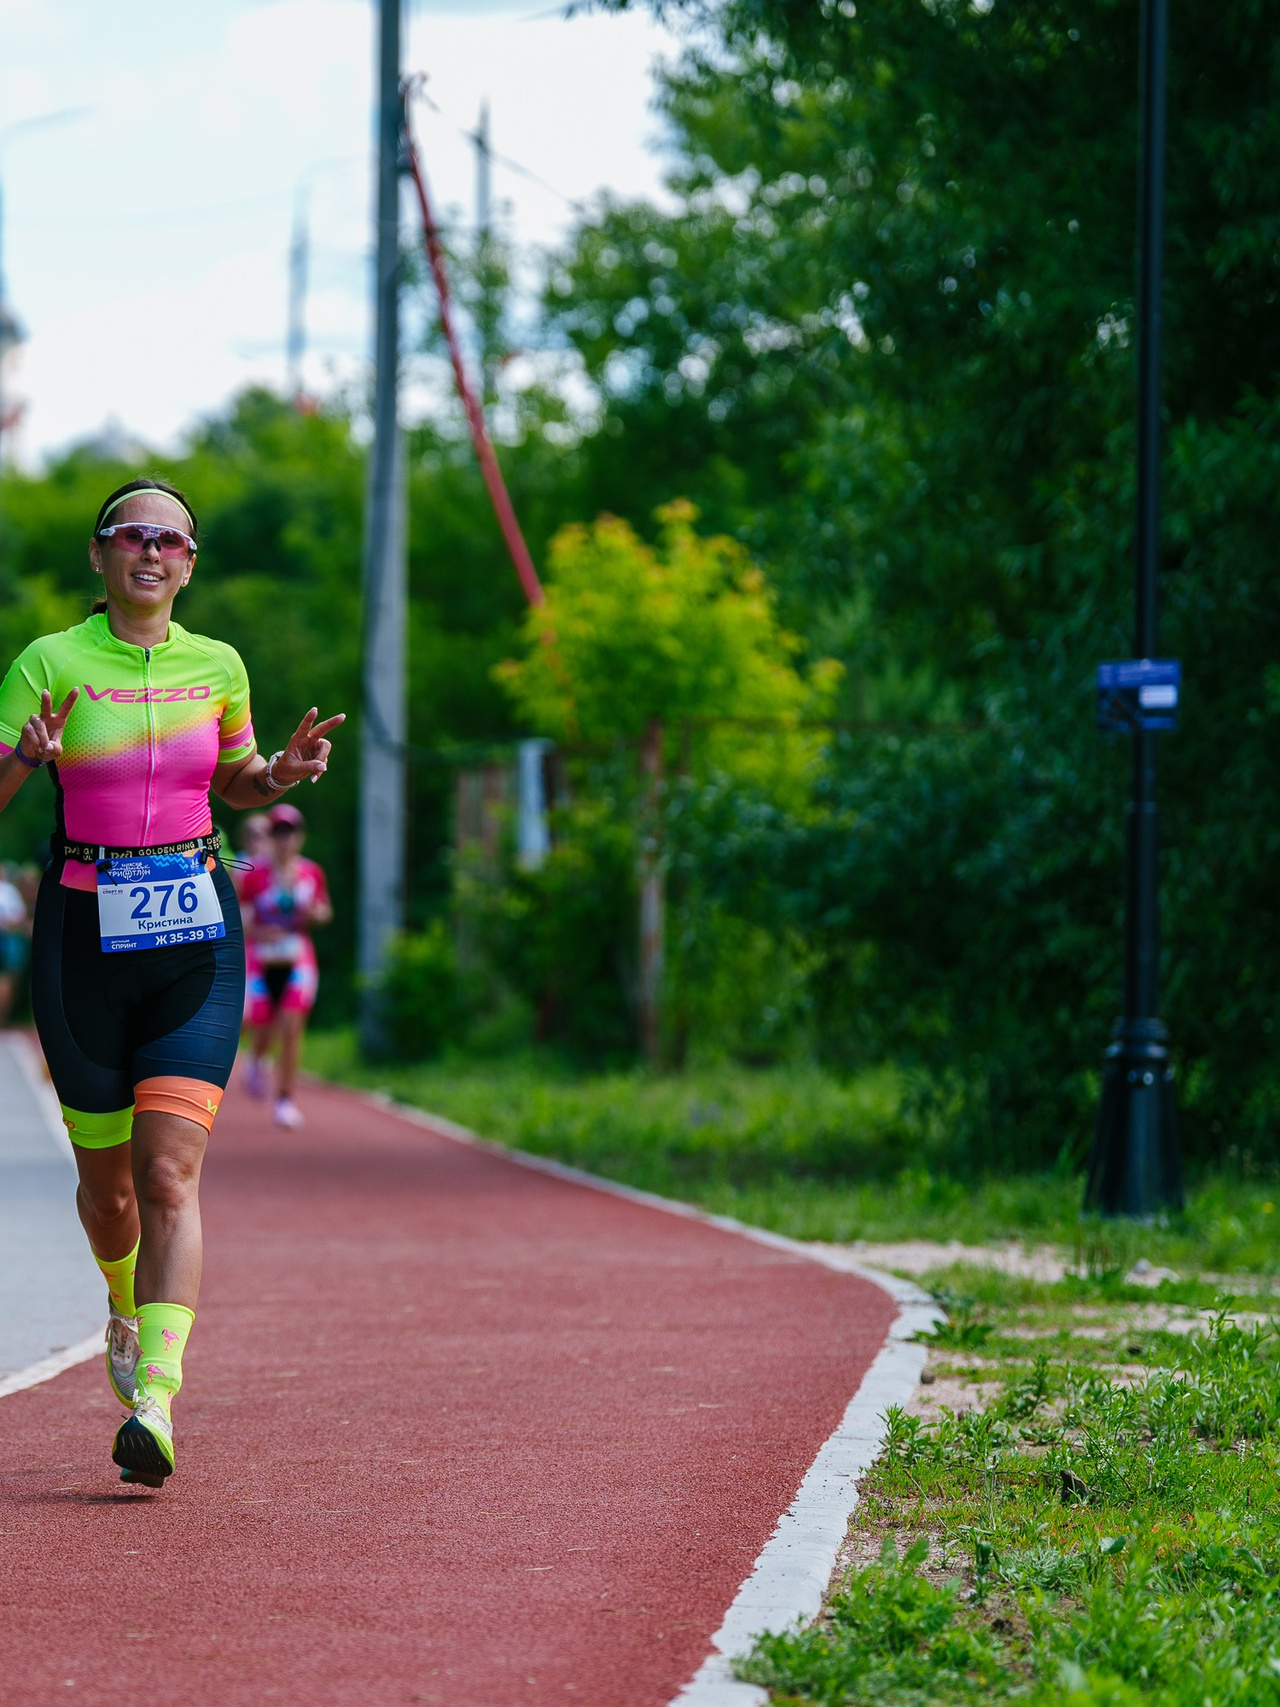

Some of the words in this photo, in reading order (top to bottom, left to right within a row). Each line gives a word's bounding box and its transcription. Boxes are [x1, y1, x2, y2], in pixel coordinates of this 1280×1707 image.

[83, 684, 210, 703] VEZZO
[138, 846, 175, 856] GOLDEN
[176, 841, 195, 851] RING
[129, 881, 198, 919] 276
[138, 916, 194, 931] Кристина
[155, 934, 167, 946] Ж
[169, 930, 204, 943] 35-39
[111, 942, 137, 950] СПРИНТ
